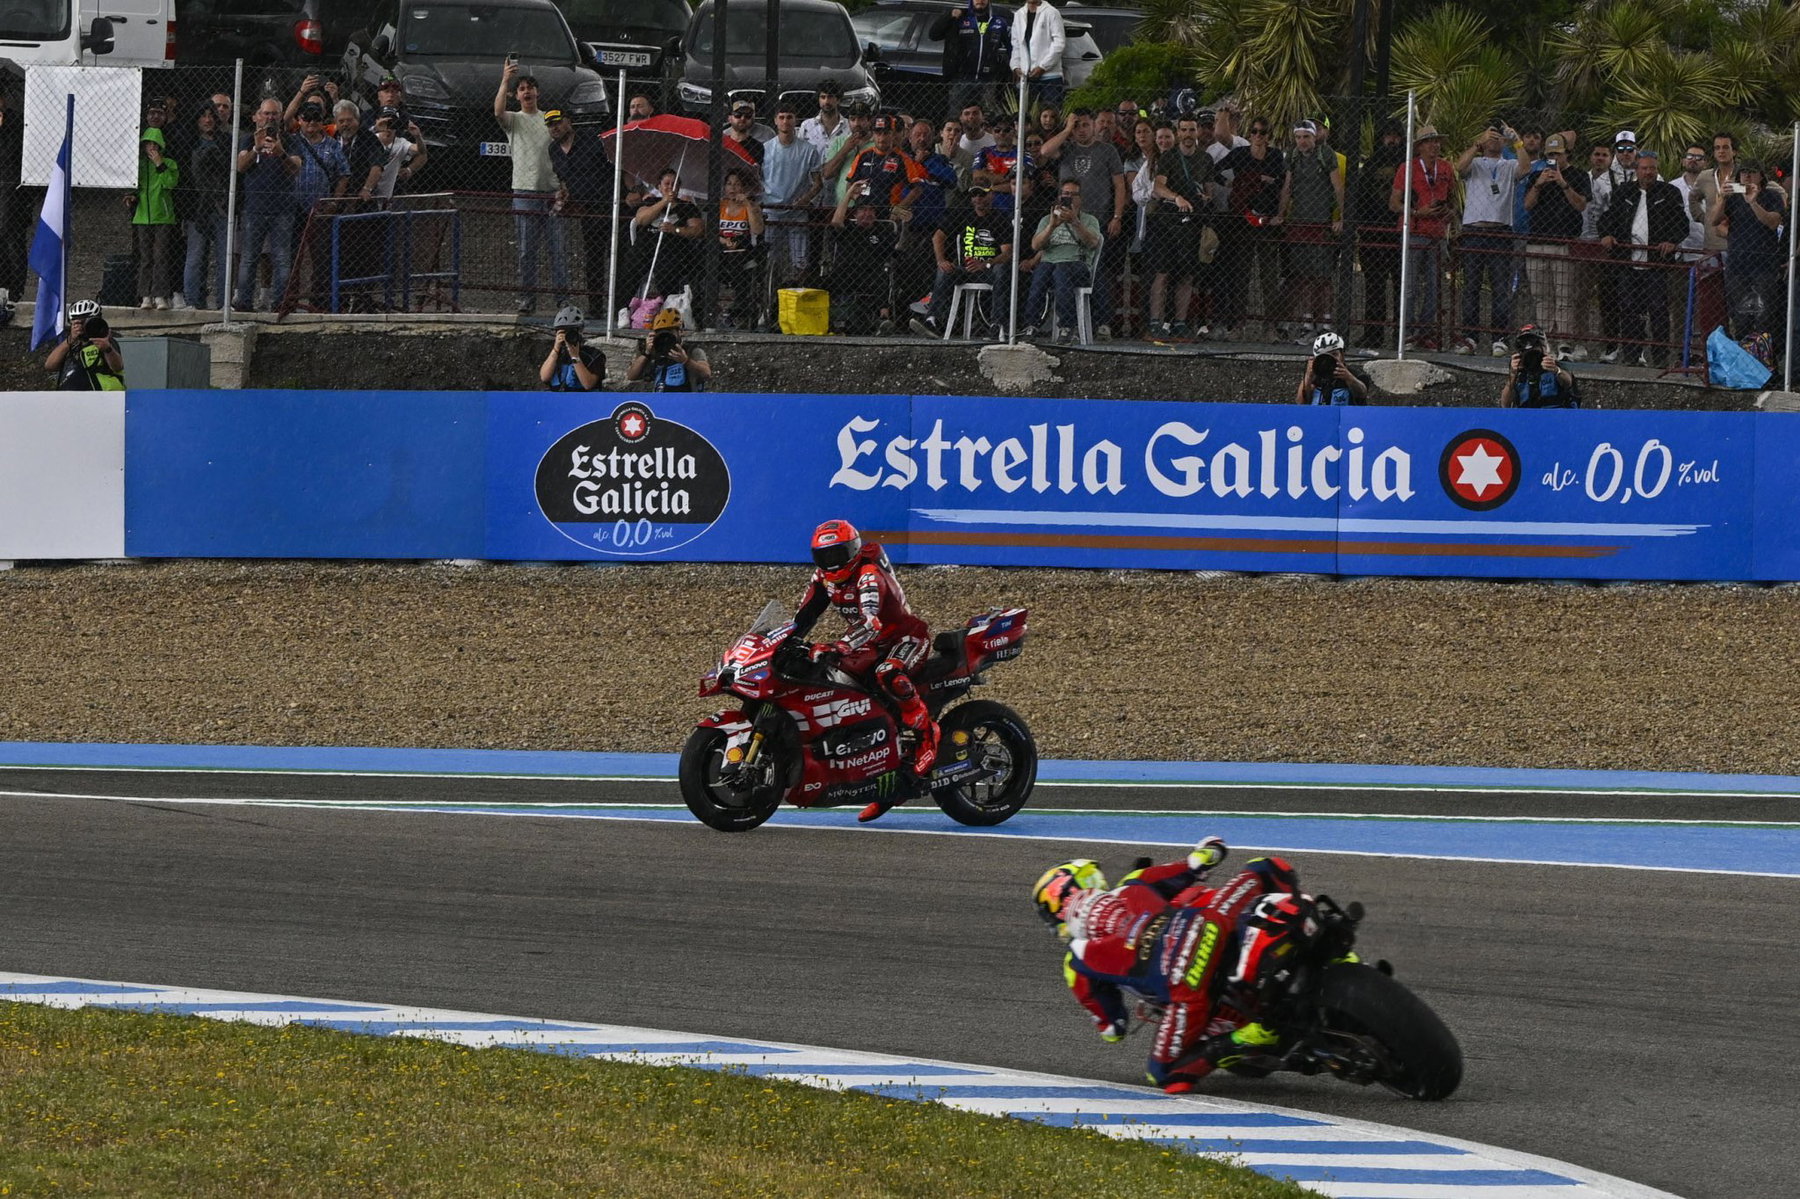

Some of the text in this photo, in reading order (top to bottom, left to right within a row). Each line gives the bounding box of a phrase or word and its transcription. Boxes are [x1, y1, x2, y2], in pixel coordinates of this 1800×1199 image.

[603, 52, 626, 62] 3527
[487, 144, 511, 154] 338
[720, 221, 749, 229] EPSO
[567, 444, 697, 480] Estrella
[829, 415, 1127, 495] Estrella
[1145, 421, 1415, 502] Galicia
[1542, 462, 1579, 491] alc.
[1585, 439, 1673, 504] 0,0
[573, 480, 691, 515] Galicia
[612, 517, 652, 548] 0,0
[741, 660, 768, 674] Lenovo
[804, 690, 834, 702] DUCATI
[838, 698, 871, 718] GIVI
[846, 747, 890, 768] NetApp
